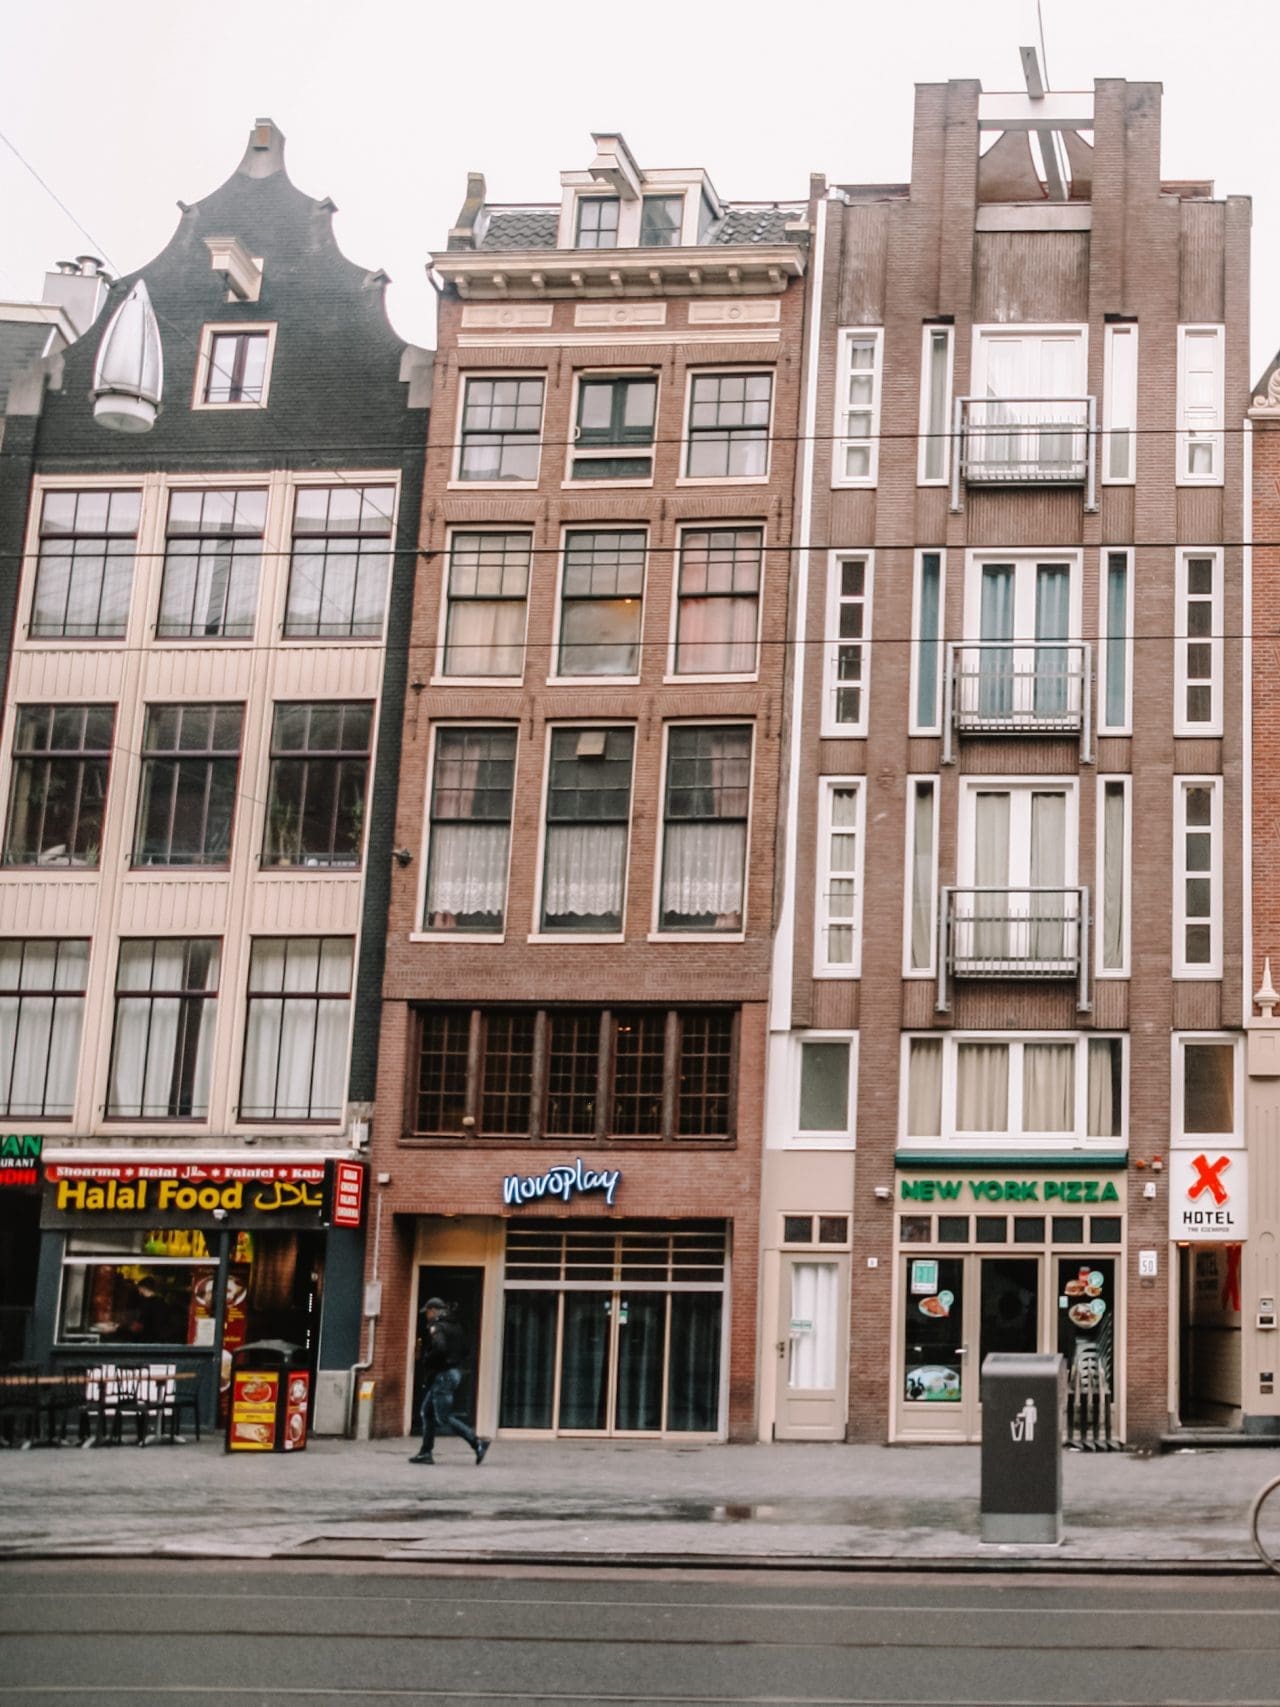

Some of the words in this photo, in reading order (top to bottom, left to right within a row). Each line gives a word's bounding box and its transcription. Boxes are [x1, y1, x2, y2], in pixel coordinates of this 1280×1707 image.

[224, 1167, 274, 1178] Falafel
[503, 1158, 620, 1205] novoplay
[57, 1179, 147, 1210] Halal
[158, 1179, 243, 1210] Food
[901, 1181, 962, 1202] NEW
[968, 1181, 1039, 1202] YORK
[1043, 1181, 1120, 1203] PIZZA
[1183, 1211, 1234, 1224] HOTEL
[1142, 1260, 1154, 1272] 50
